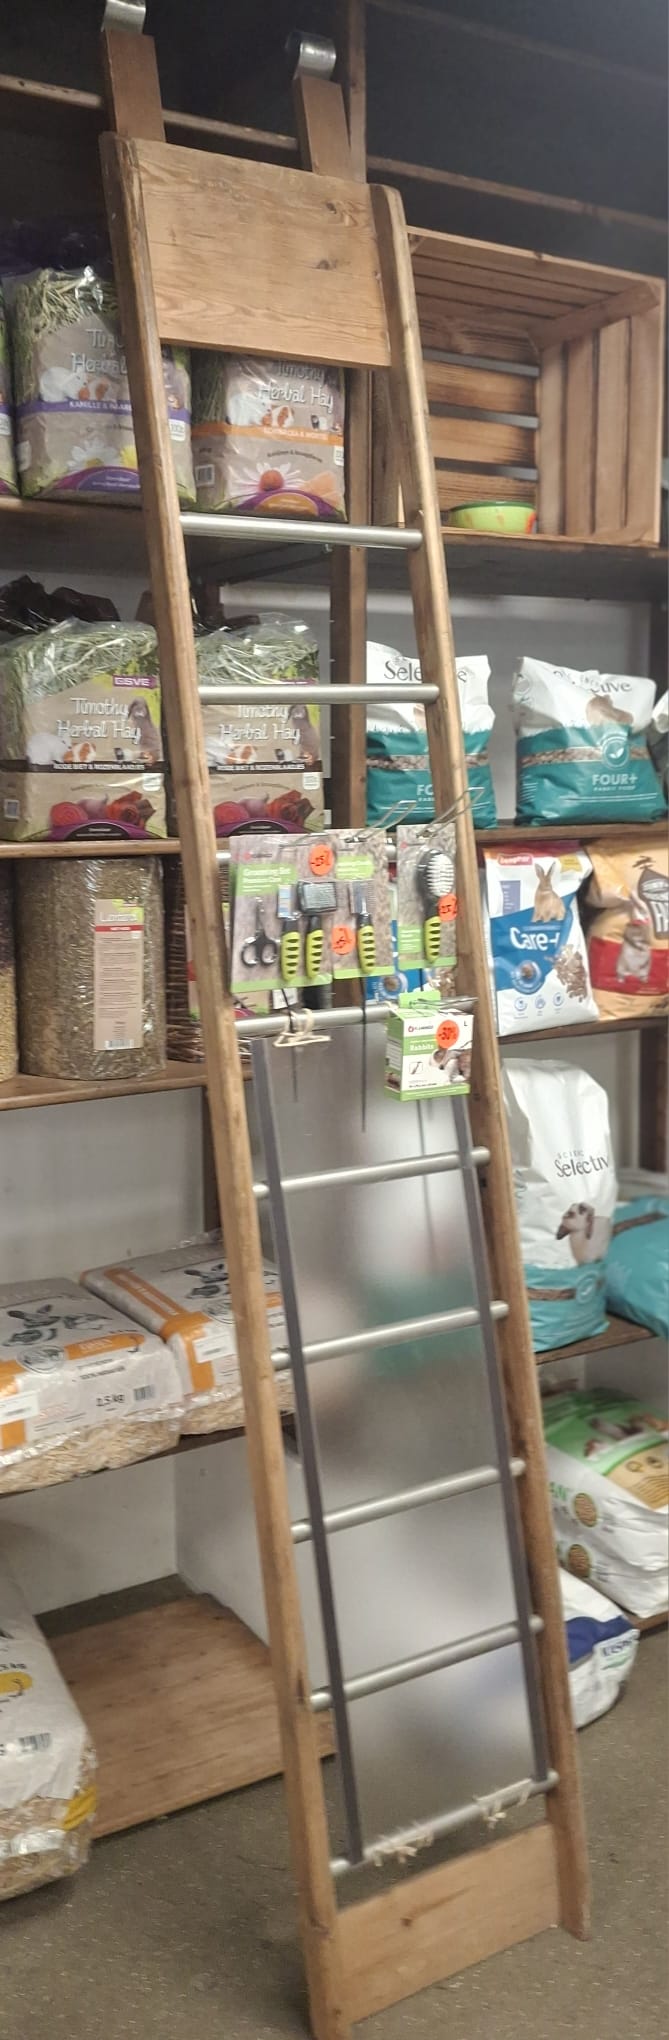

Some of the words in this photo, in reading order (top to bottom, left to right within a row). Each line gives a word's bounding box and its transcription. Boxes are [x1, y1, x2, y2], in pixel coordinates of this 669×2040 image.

[311, 385, 334, 414] Hay
[70, 697, 129, 721] Timothy
[57, 719, 108, 739] Herbal
[112, 719, 141, 745] Hay
[219, 723, 269, 742] Herbal
[271, 723, 301, 745] Hay
[592, 773, 639, 786] FOUR+
[554, 1155, 609, 1178] Selectiv
